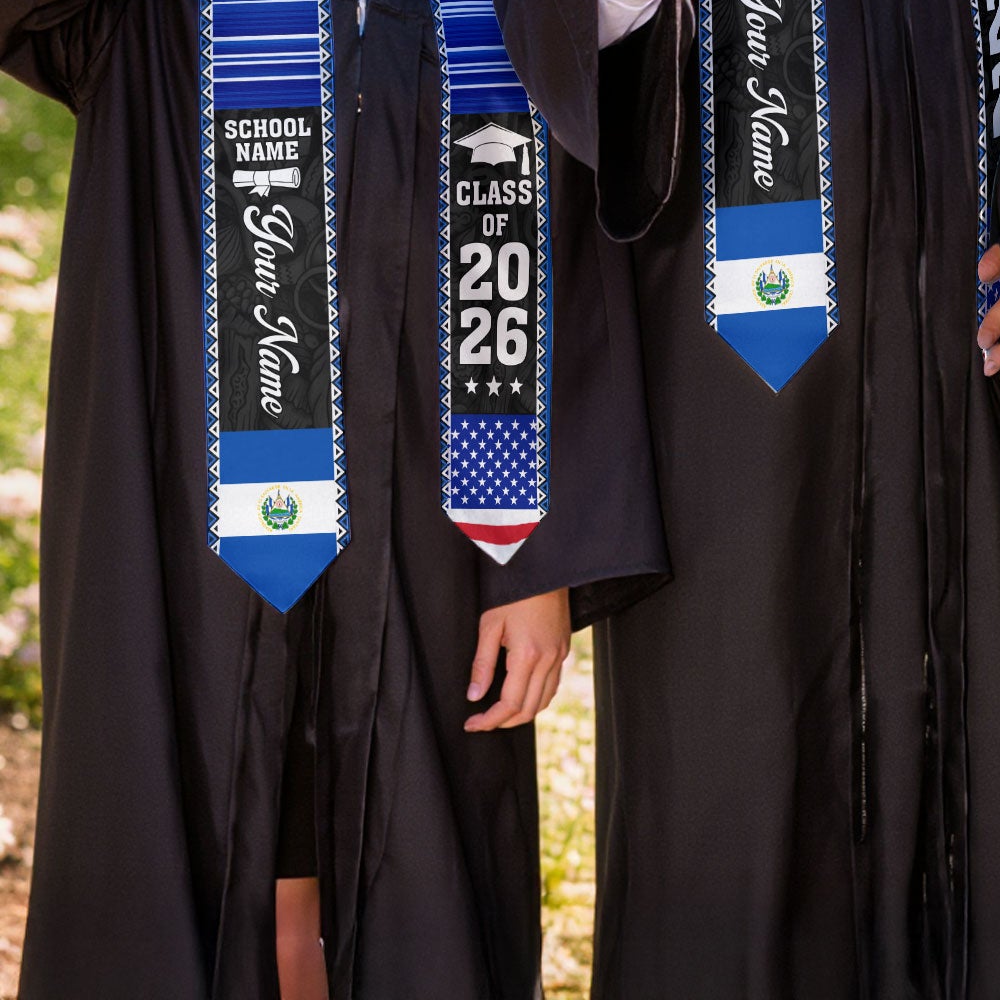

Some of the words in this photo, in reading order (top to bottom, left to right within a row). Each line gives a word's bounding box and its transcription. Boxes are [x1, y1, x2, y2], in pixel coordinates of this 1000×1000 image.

[224, 117, 312, 140] SCHOOL
[235, 141, 299, 162] NAME
[746, 77, 789, 192] Name
[456, 180, 533, 206] CLASS
[243, 204, 295, 299] Your
[482, 213, 509, 237] OF
[459, 242, 530, 301] 20
[253, 304, 300, 419] Name
[459, 307, 529, 366] 26
